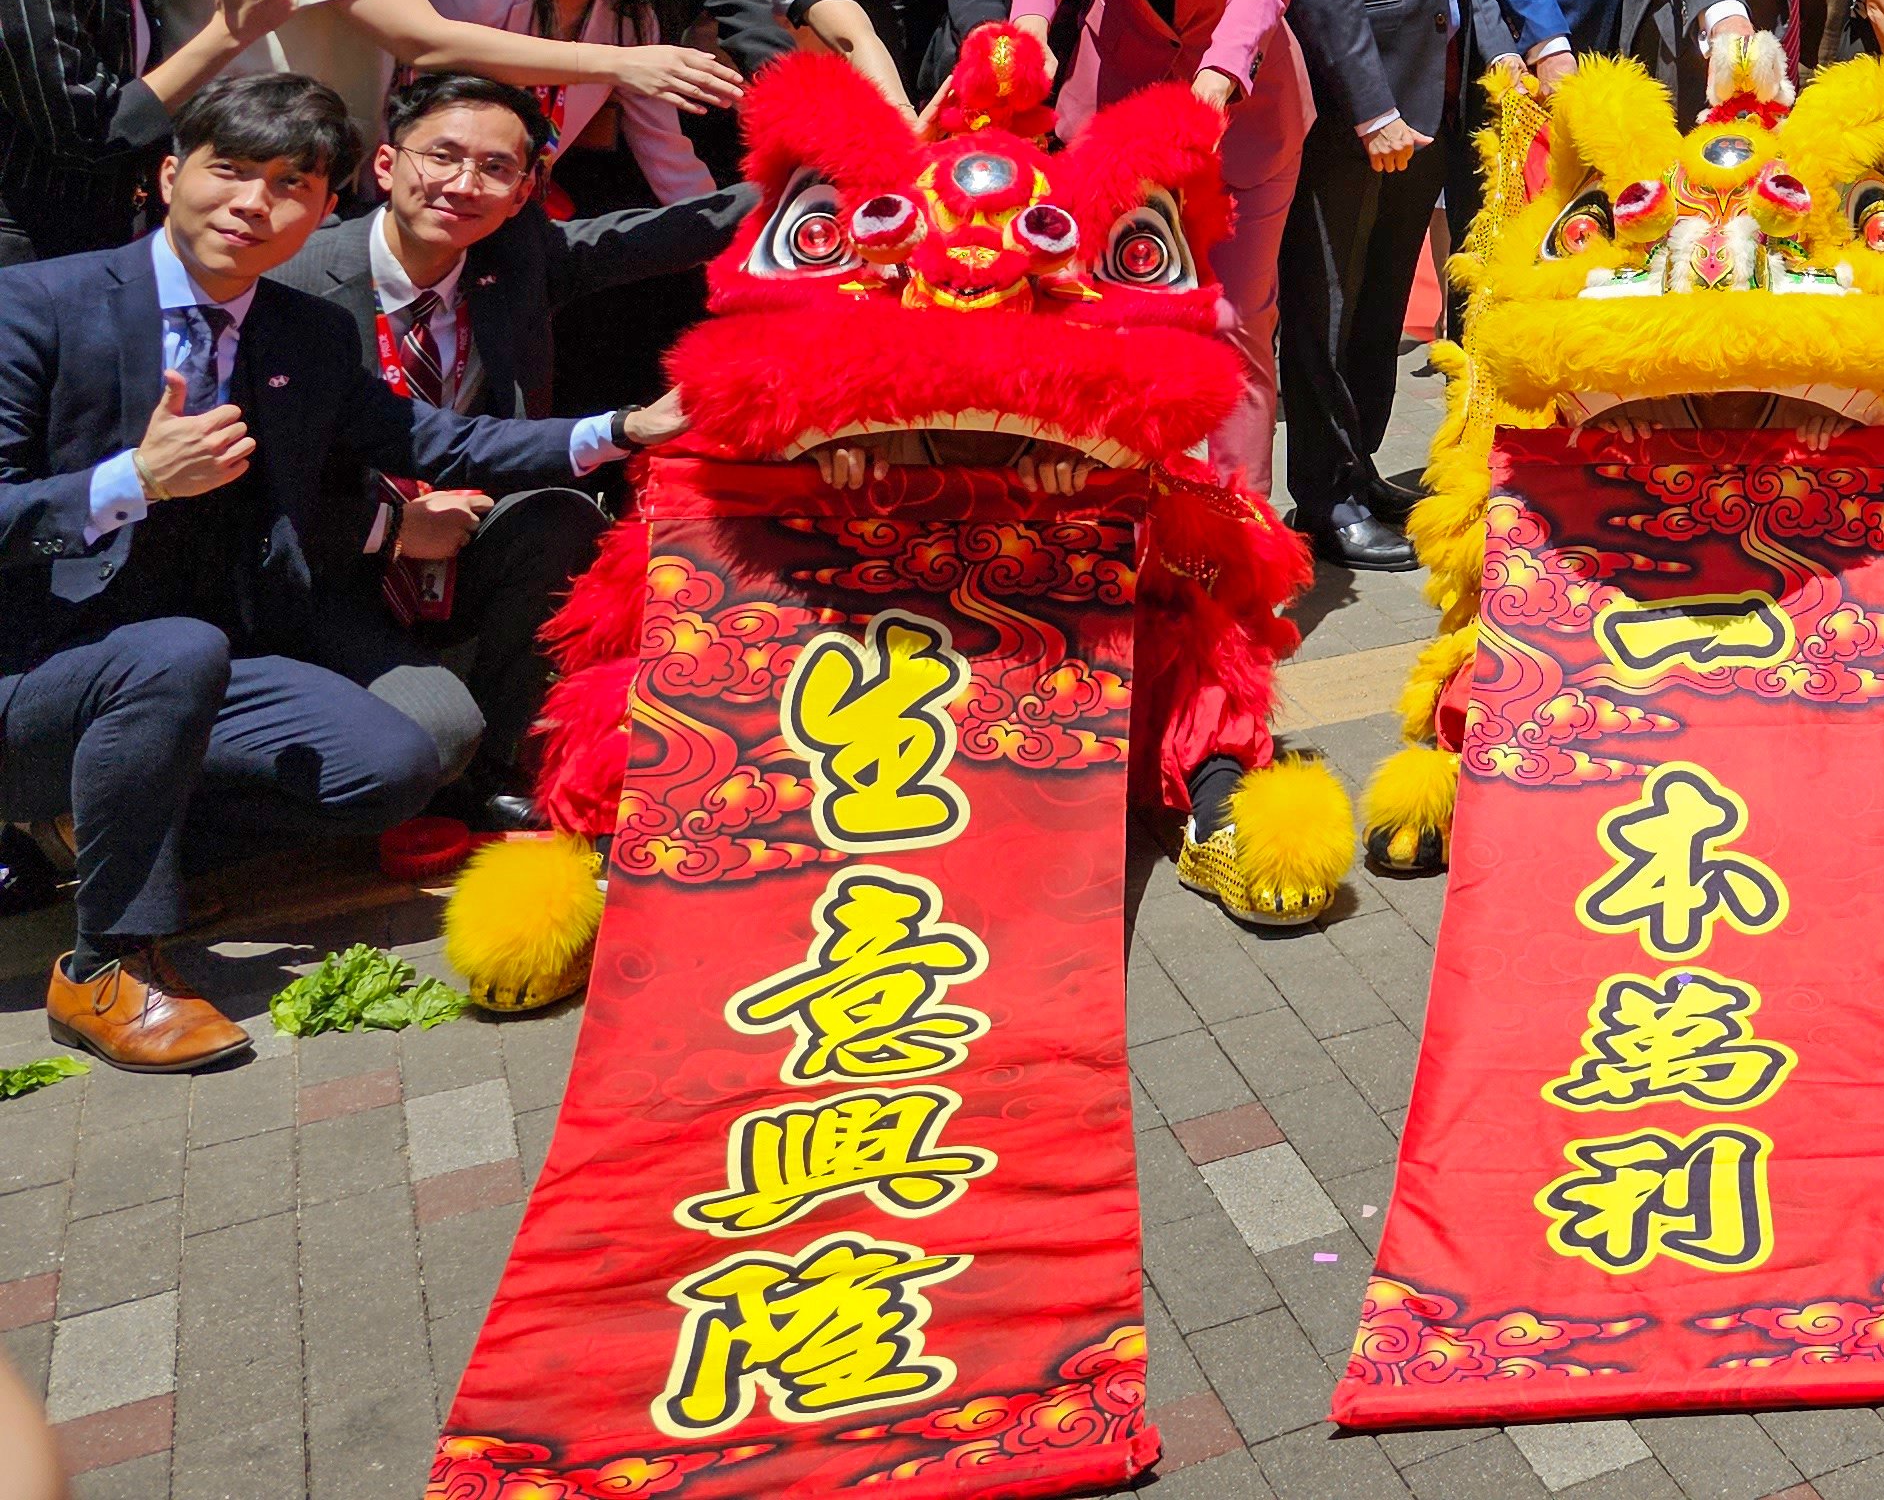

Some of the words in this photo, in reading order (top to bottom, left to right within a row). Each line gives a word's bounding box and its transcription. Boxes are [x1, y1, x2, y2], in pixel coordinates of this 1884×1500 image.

[650, 606, 998, 1440] 生意興隆
[1532, 588, 1799, 1276] 一本萬利
